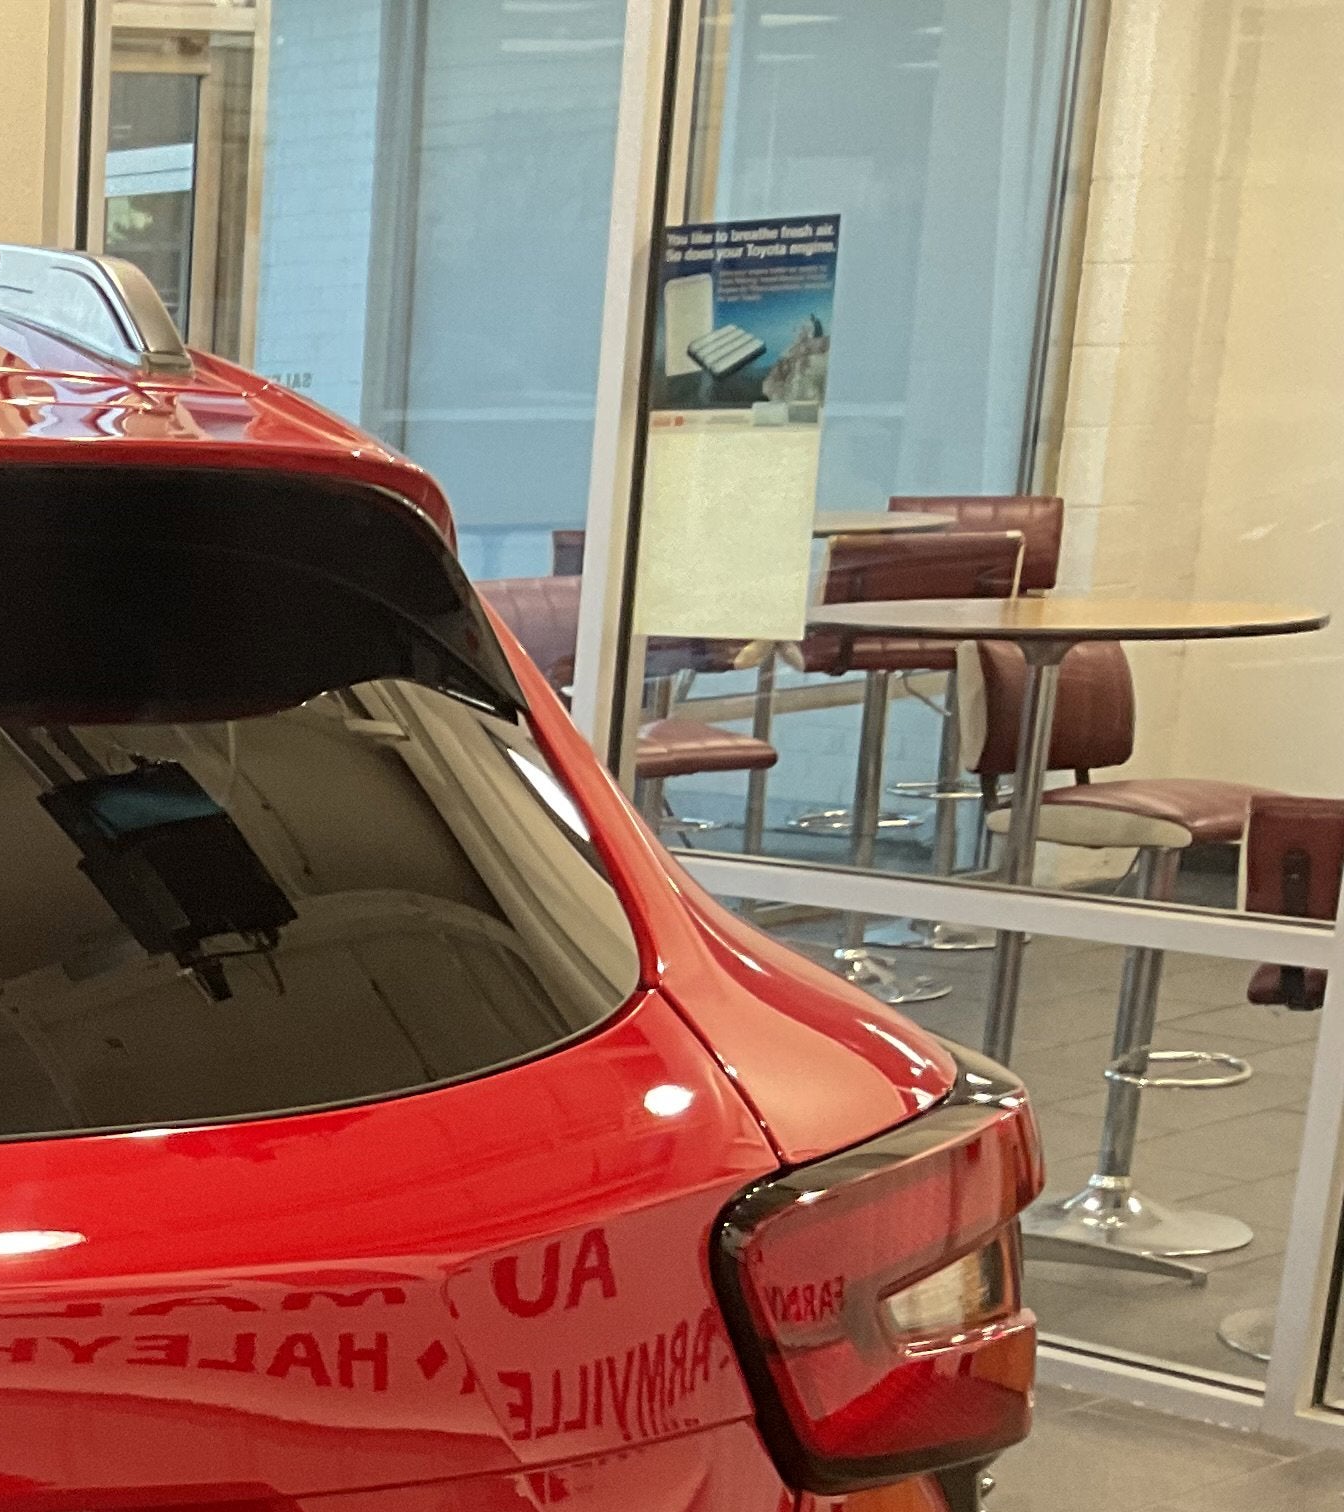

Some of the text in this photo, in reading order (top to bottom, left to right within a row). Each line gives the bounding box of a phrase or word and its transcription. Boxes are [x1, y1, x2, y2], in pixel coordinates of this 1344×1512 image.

[666, 232, 688, 246] You
[691, 229, 713, 244] like
[715, 230, 728, 243] to
[731, 226, 778, 242] breathe
[780, 224, 812, 238] fresh
[684, 248, 714, 261] does
[716, 247, 744, 262] your
[746, 243, 786, 258] Toyota
